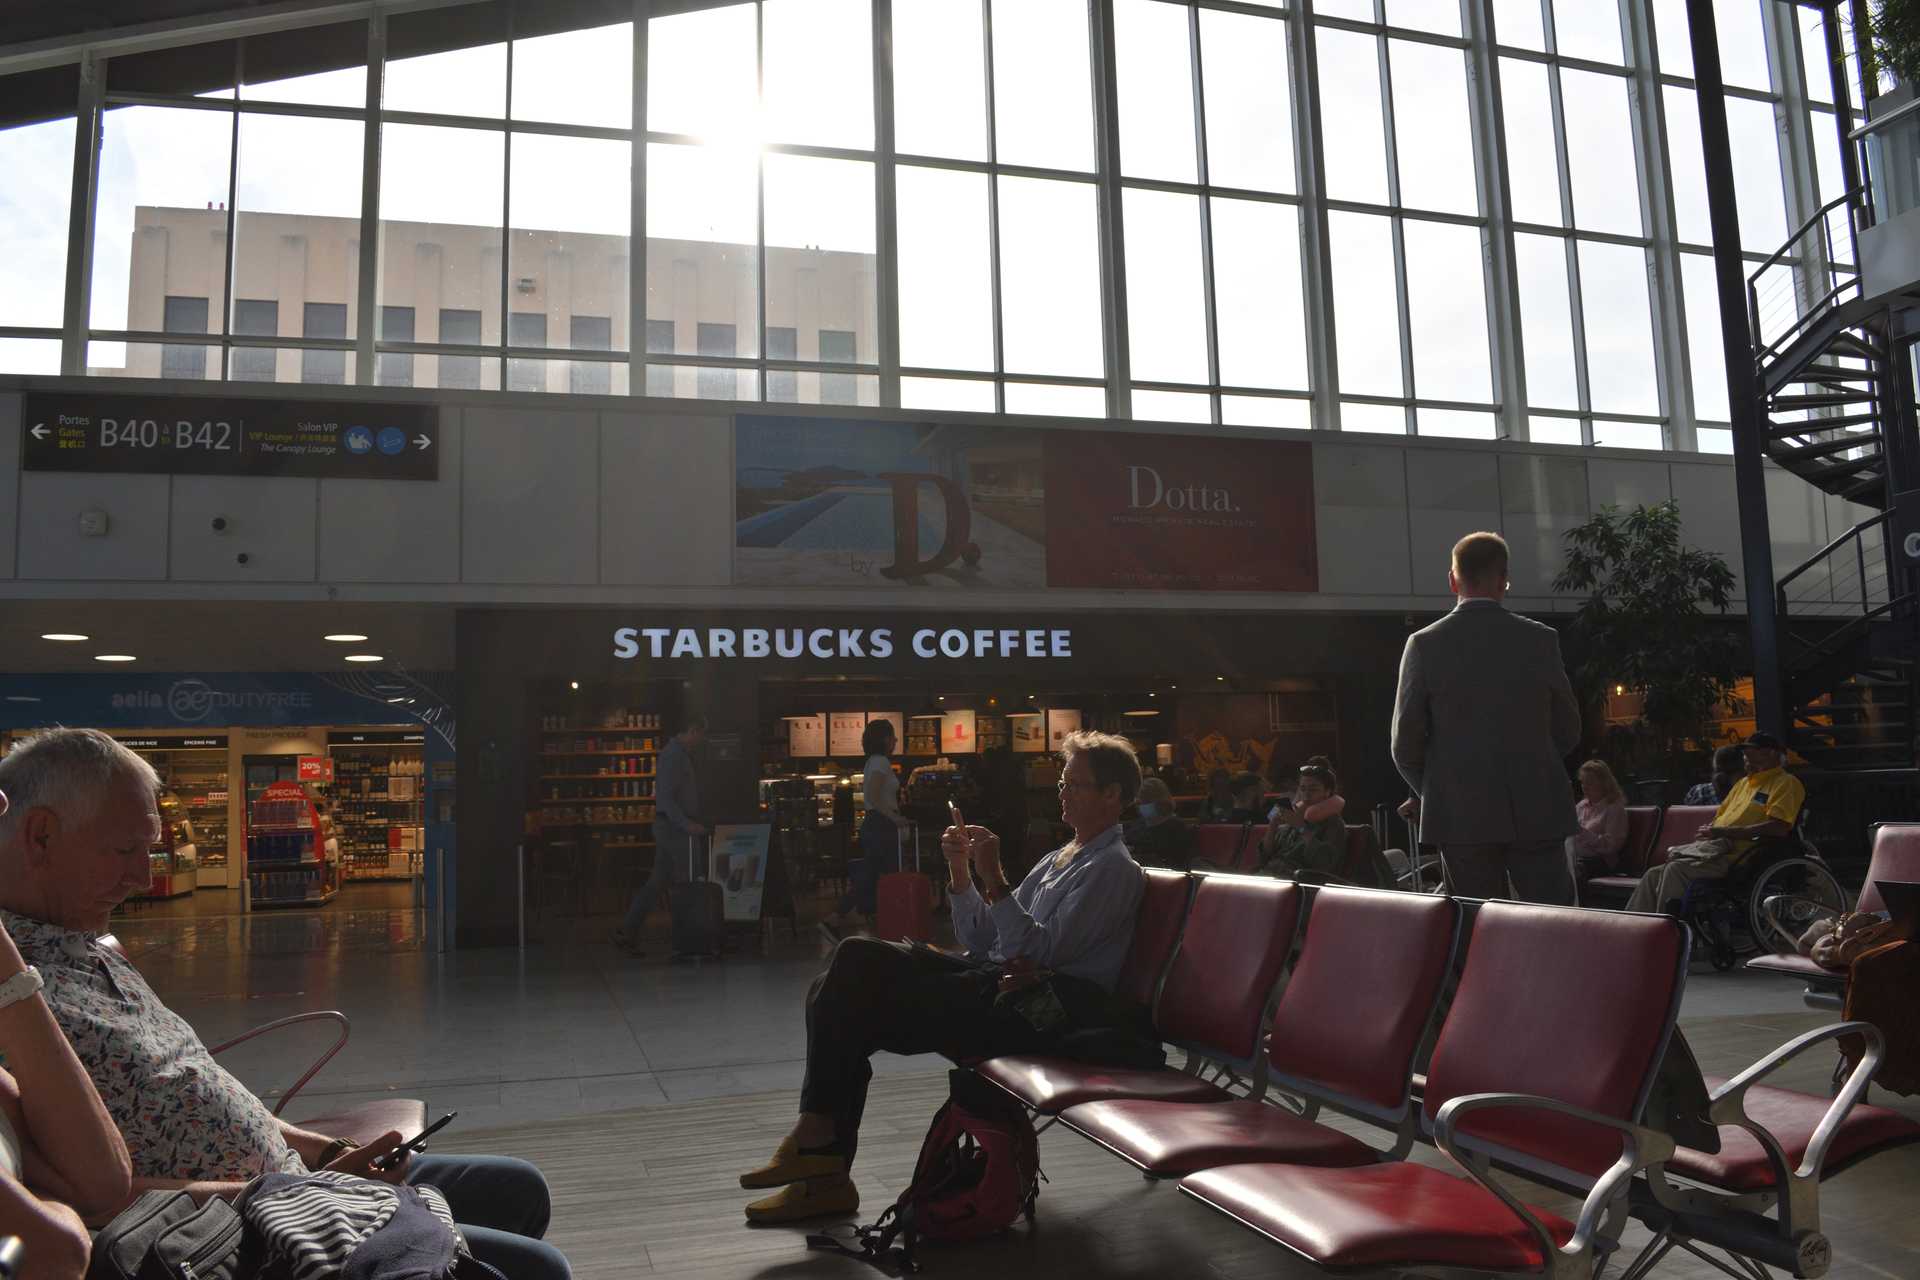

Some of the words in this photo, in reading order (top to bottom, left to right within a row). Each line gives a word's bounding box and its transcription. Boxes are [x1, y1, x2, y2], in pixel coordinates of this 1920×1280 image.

[58, 414, 89, 425] Portes
[58, 428, 85, 438] Gates
[100, 418, 158, 447] B40
[297, 422, 321, 432] Salon
[323, 423, 338, 433] VIP
[175, 421, 231, 450] B42
[308, 445, 337, 455] Lounge
[1127, 464, 1241, 512] Dotta.
[612, 627, 894, 660] STARBUCKS
[911, 627, 1073, 660] COFFEE
[266, 788, 304, 797] SPECIAL
